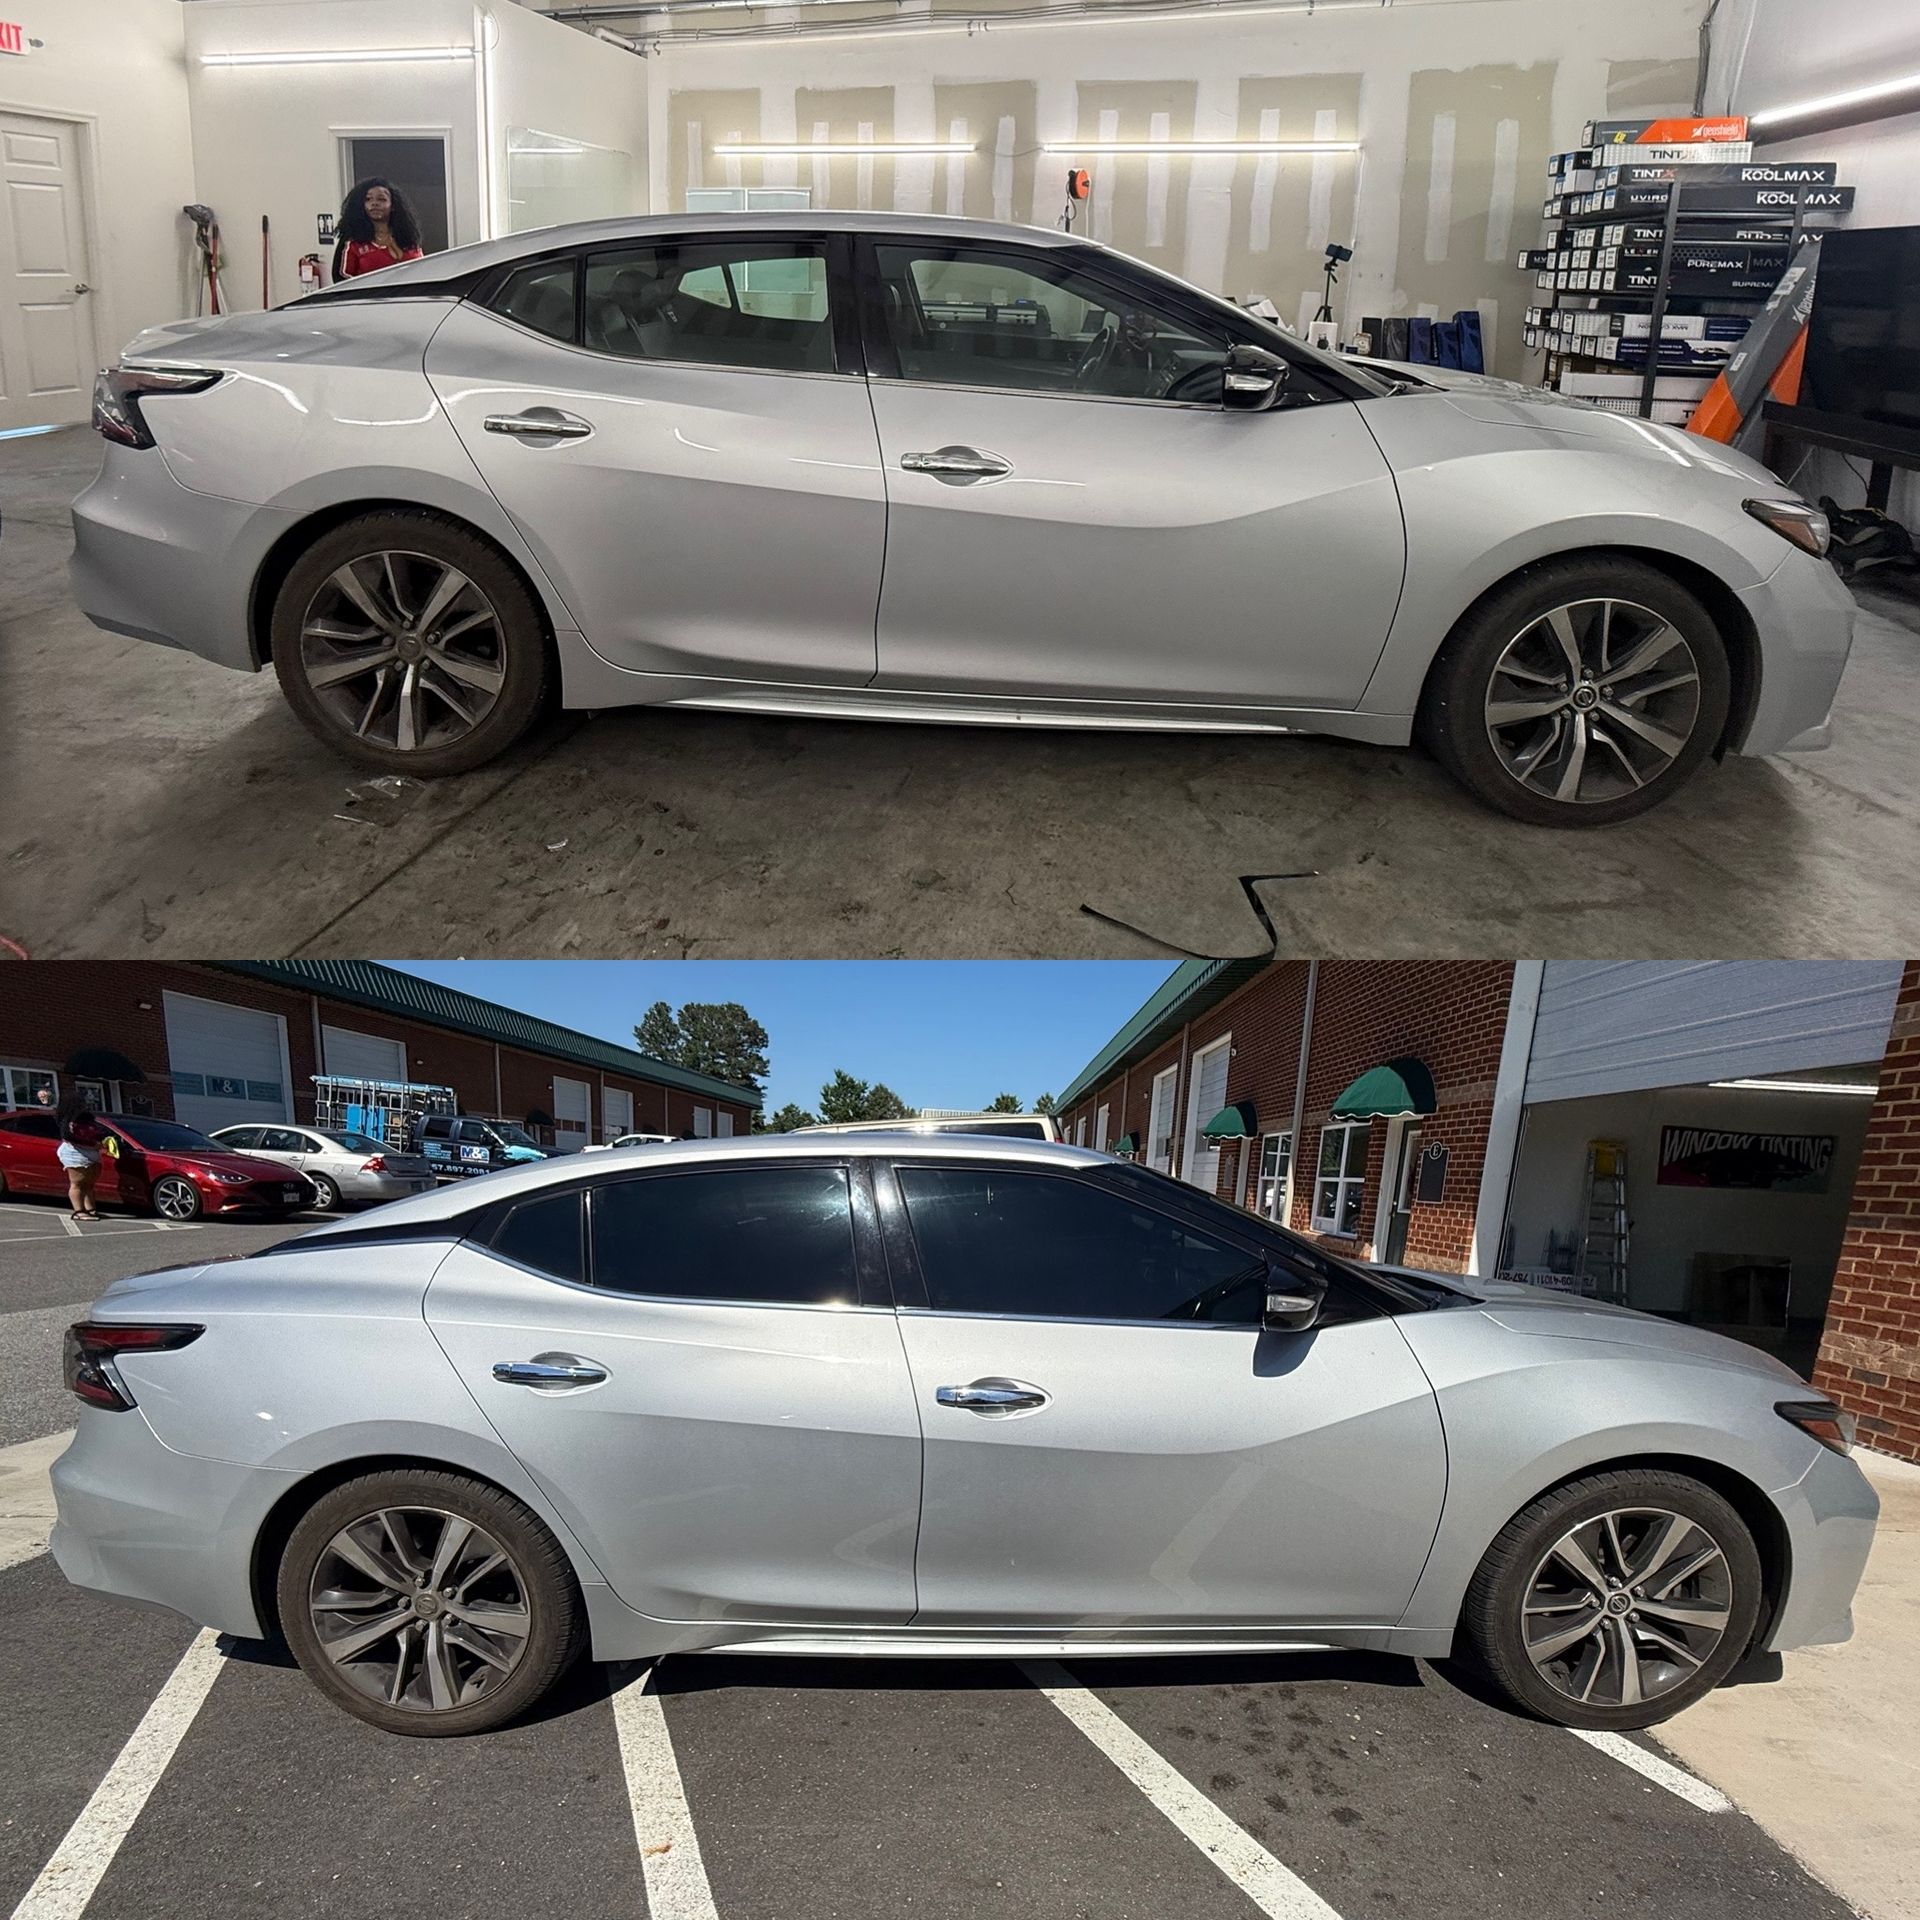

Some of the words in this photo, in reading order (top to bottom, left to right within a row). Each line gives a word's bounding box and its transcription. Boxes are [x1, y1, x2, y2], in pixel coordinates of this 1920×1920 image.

[1649, 149, 1690, 160] TINT
[1742, 169, 1825, 181] KOOLMAX
[1634, 228, 1664, 238] TINT
[1687, 259, 1743, 269] PUREMAX
[1628, 275, 1658, 285] TINT
[1663, 1129, 1757, 1166] WINDOW
[1759, 1136, 1832, 1175] TINTING
[431, 1163, 490, 1175] 57.897.2081
